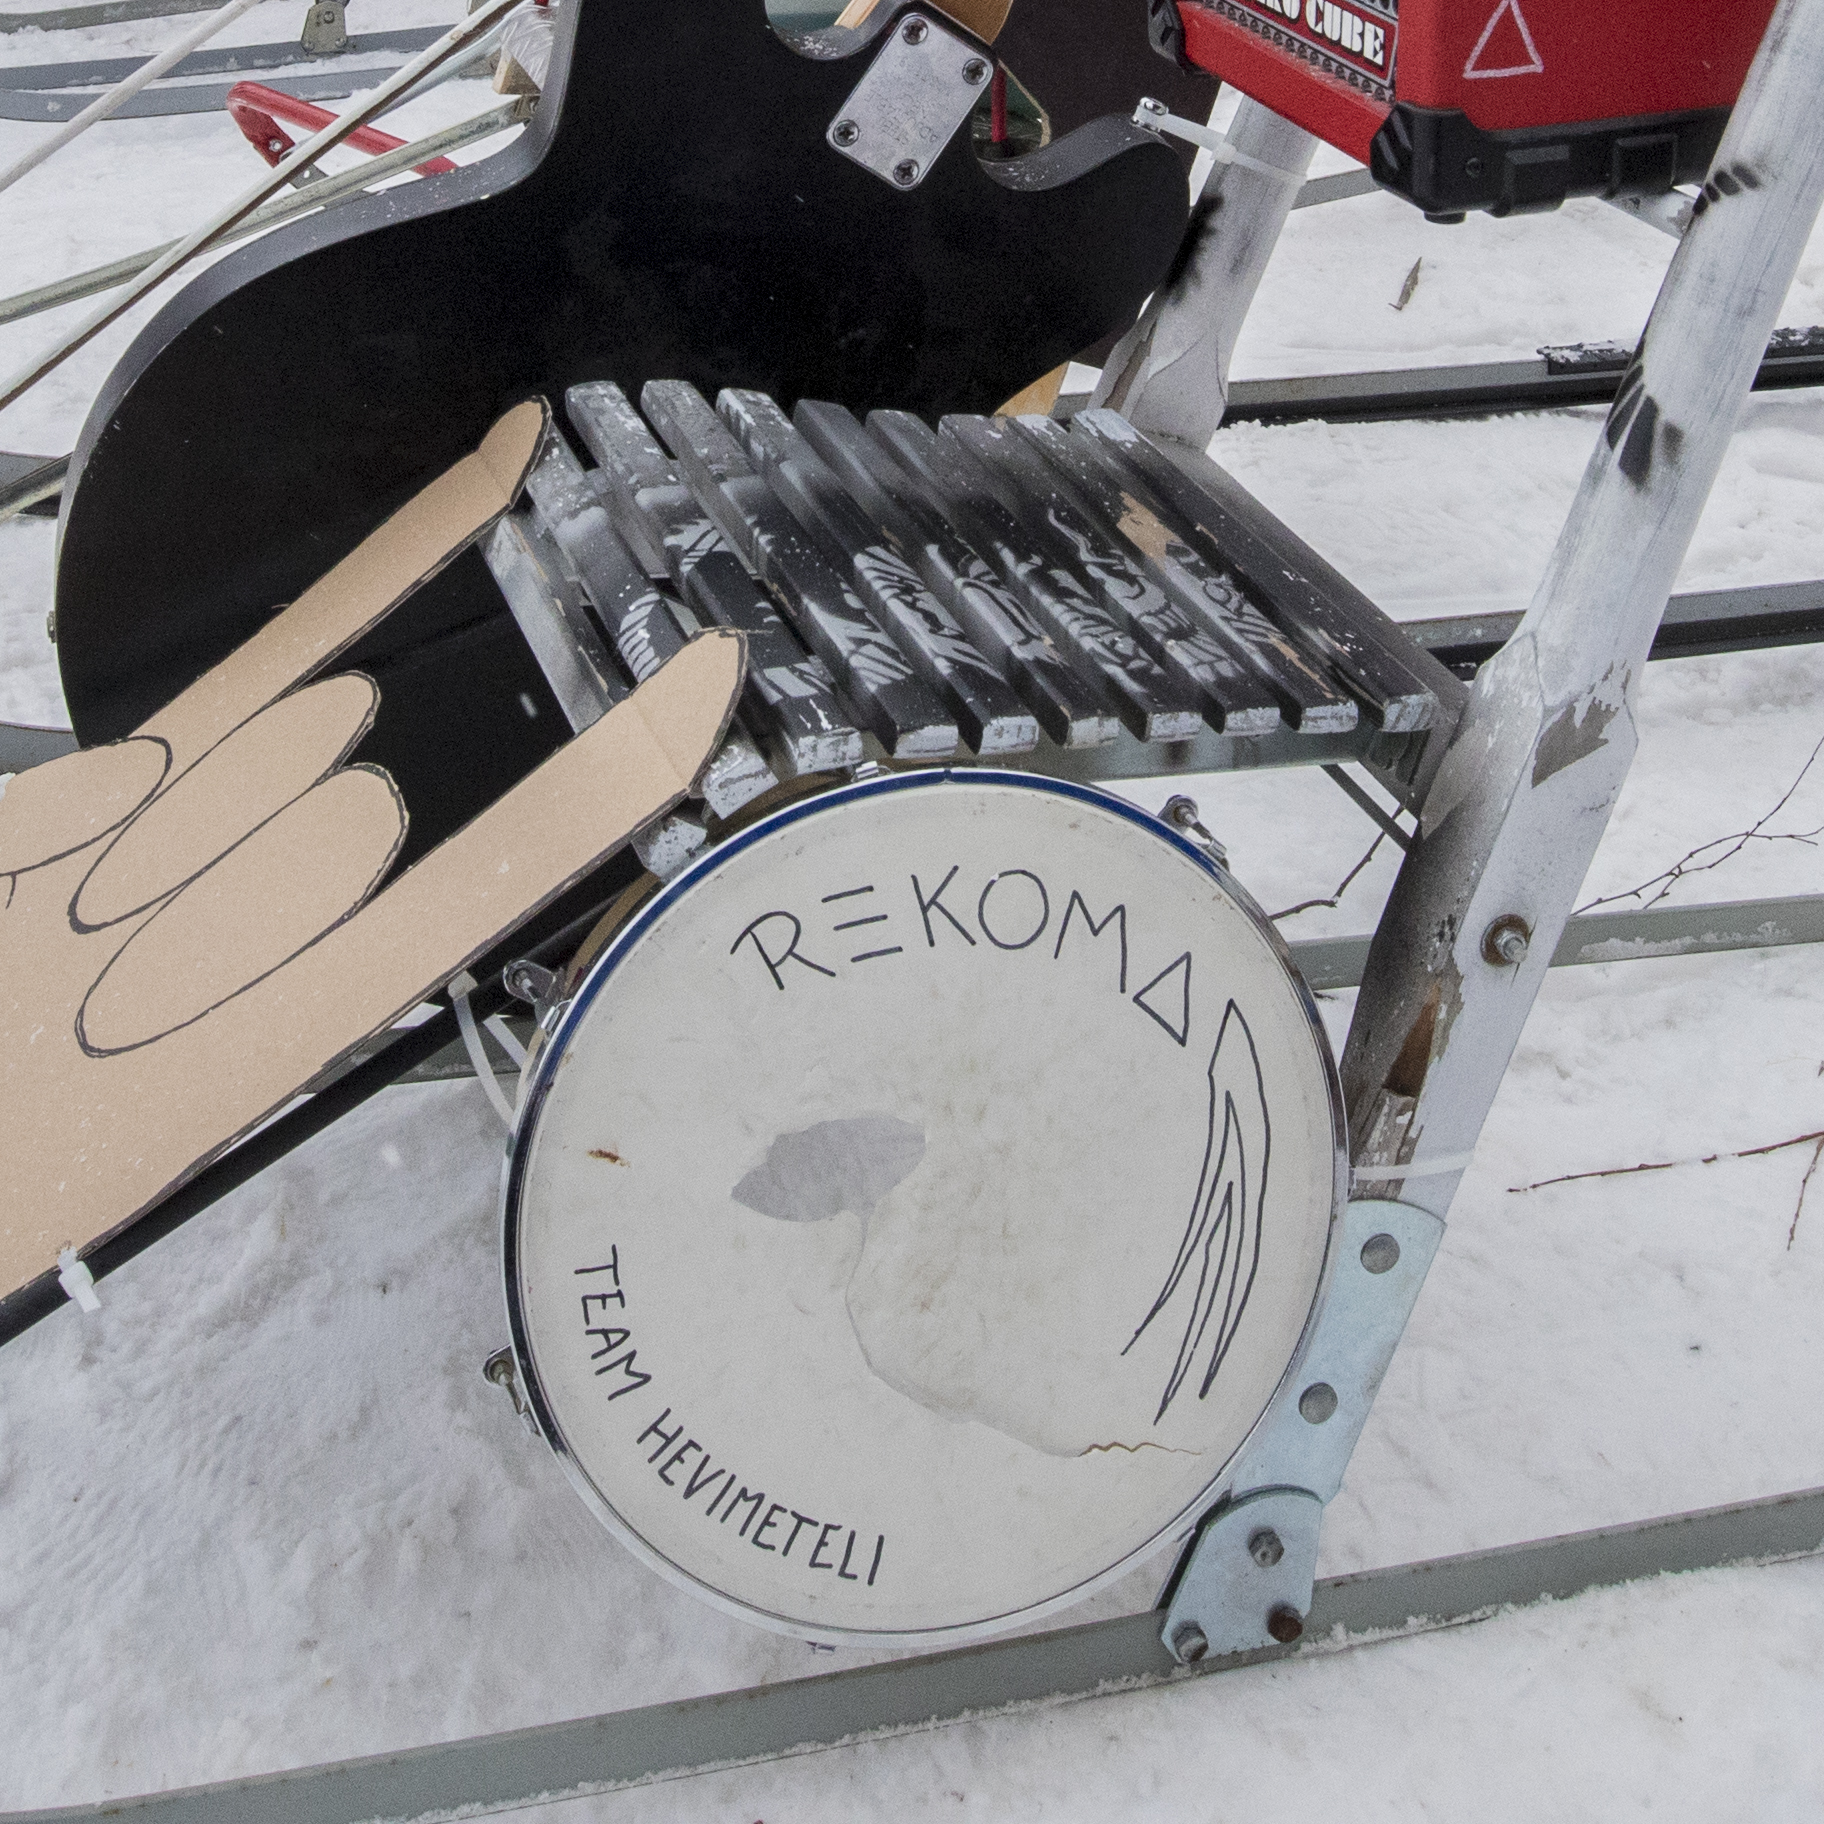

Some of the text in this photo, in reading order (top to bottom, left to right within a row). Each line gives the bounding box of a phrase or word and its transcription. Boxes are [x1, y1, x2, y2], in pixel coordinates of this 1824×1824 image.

[730, 864, 1191, 1046] REKOMA
[573, 1243, 887, 1586] TEAM HEVIMETELI
